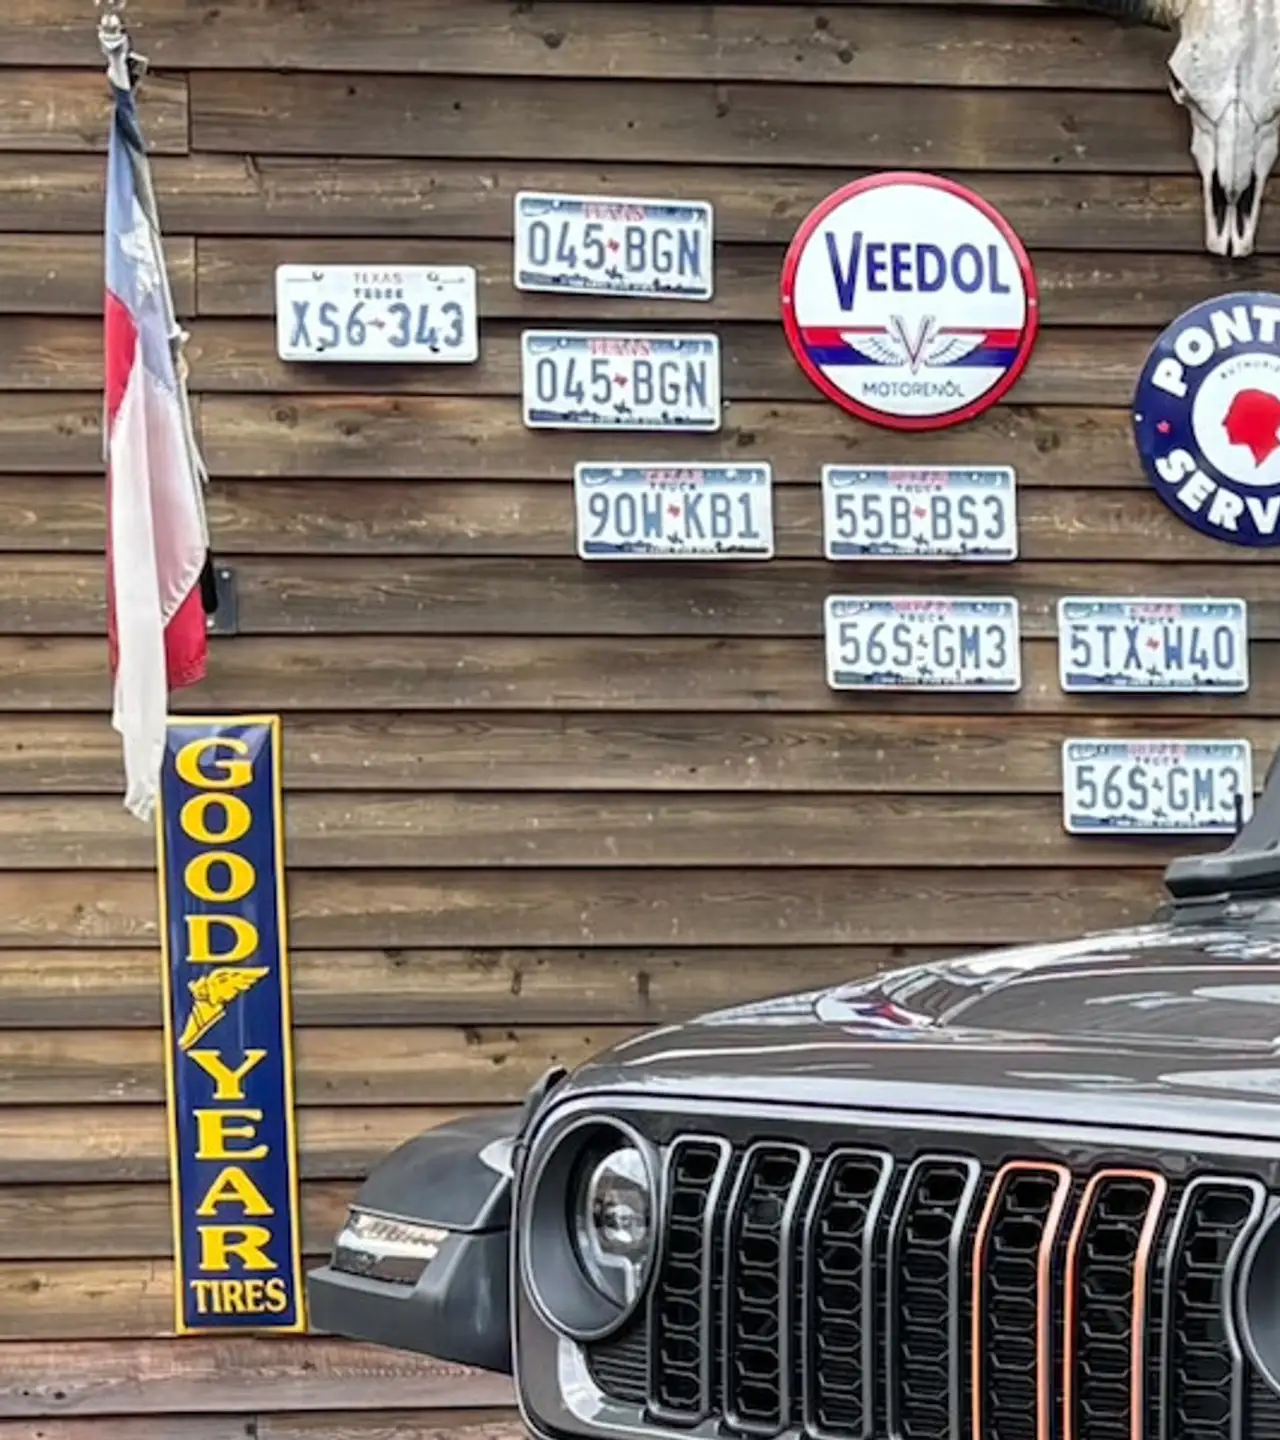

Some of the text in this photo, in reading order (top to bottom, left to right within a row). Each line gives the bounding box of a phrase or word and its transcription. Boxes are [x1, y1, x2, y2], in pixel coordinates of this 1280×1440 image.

[625, 227, 702, 276] BGN
[824, 230, 1011, 312] VEEDOL
[387, 301, 465, 348] 343
[632, 360, 708, 407] BGN
[683, 492, 760, 539] KB1
[835, 493, 1006, 541] 55B BS3
[839, 621, 1008, 669] 56S GM3
[1069, 624, 1143, 671] 5TX
[1075, 765, 1240, 813] 56S GM3
[190, 1278, 287, 1314] TIRES
